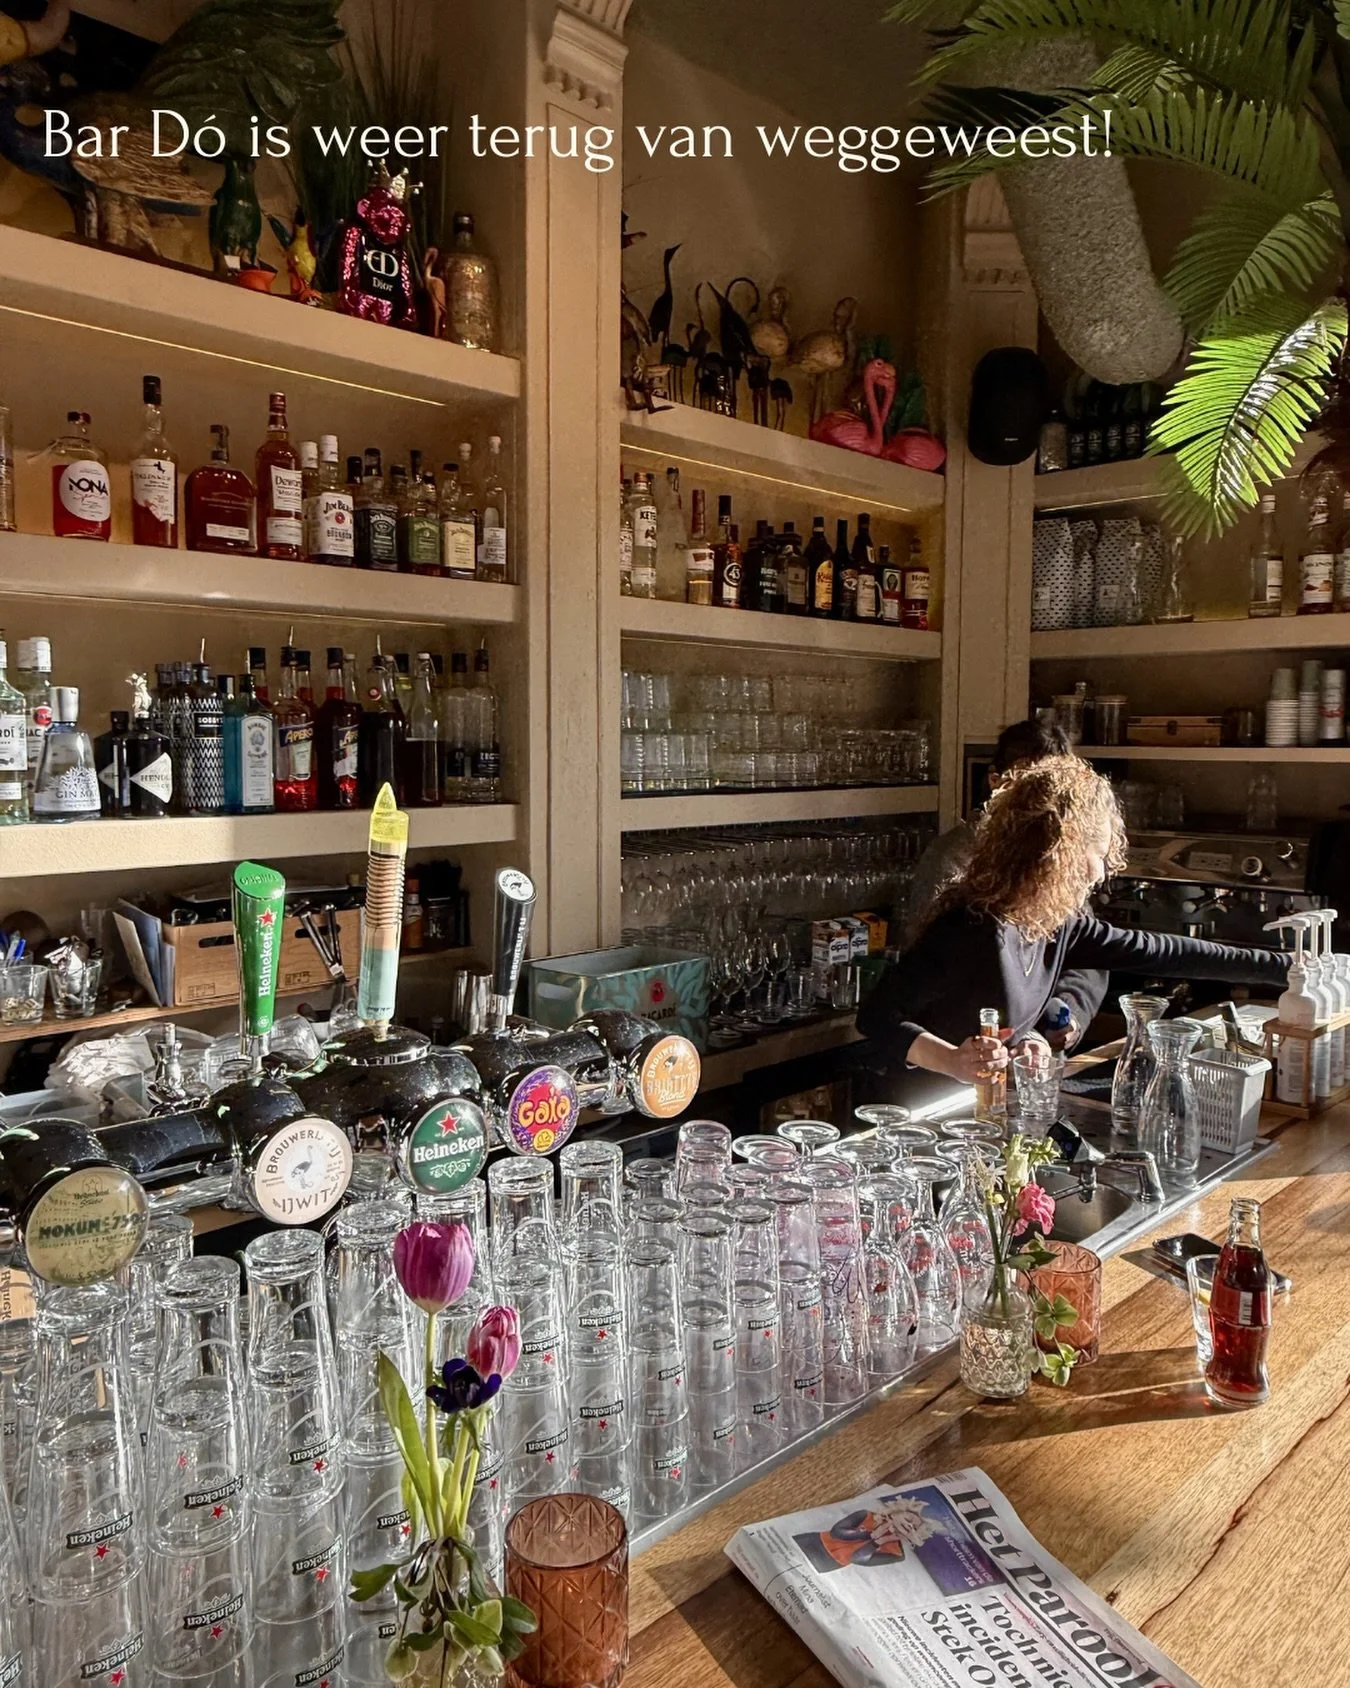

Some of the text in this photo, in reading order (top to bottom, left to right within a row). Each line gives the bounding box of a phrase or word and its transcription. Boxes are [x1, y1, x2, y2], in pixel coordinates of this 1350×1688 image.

[372, 276, 393, 291] Dior
[258, 930, 275, 998] Heineken
[413, 1134, 485, 1164] Heineken
[186, 1476, 243, 1508] Heineken
[68, 1512, 133, 1547] Heineken
[949, 1487, 1161, 1688] Het Parool
[184, 1595, 243, 1629] Heineken
[979, 1594, 1039, 1658] Toch
[83, 1631, 144, 1678] Heineken
[920, 1610, 976, 1665] Stek
